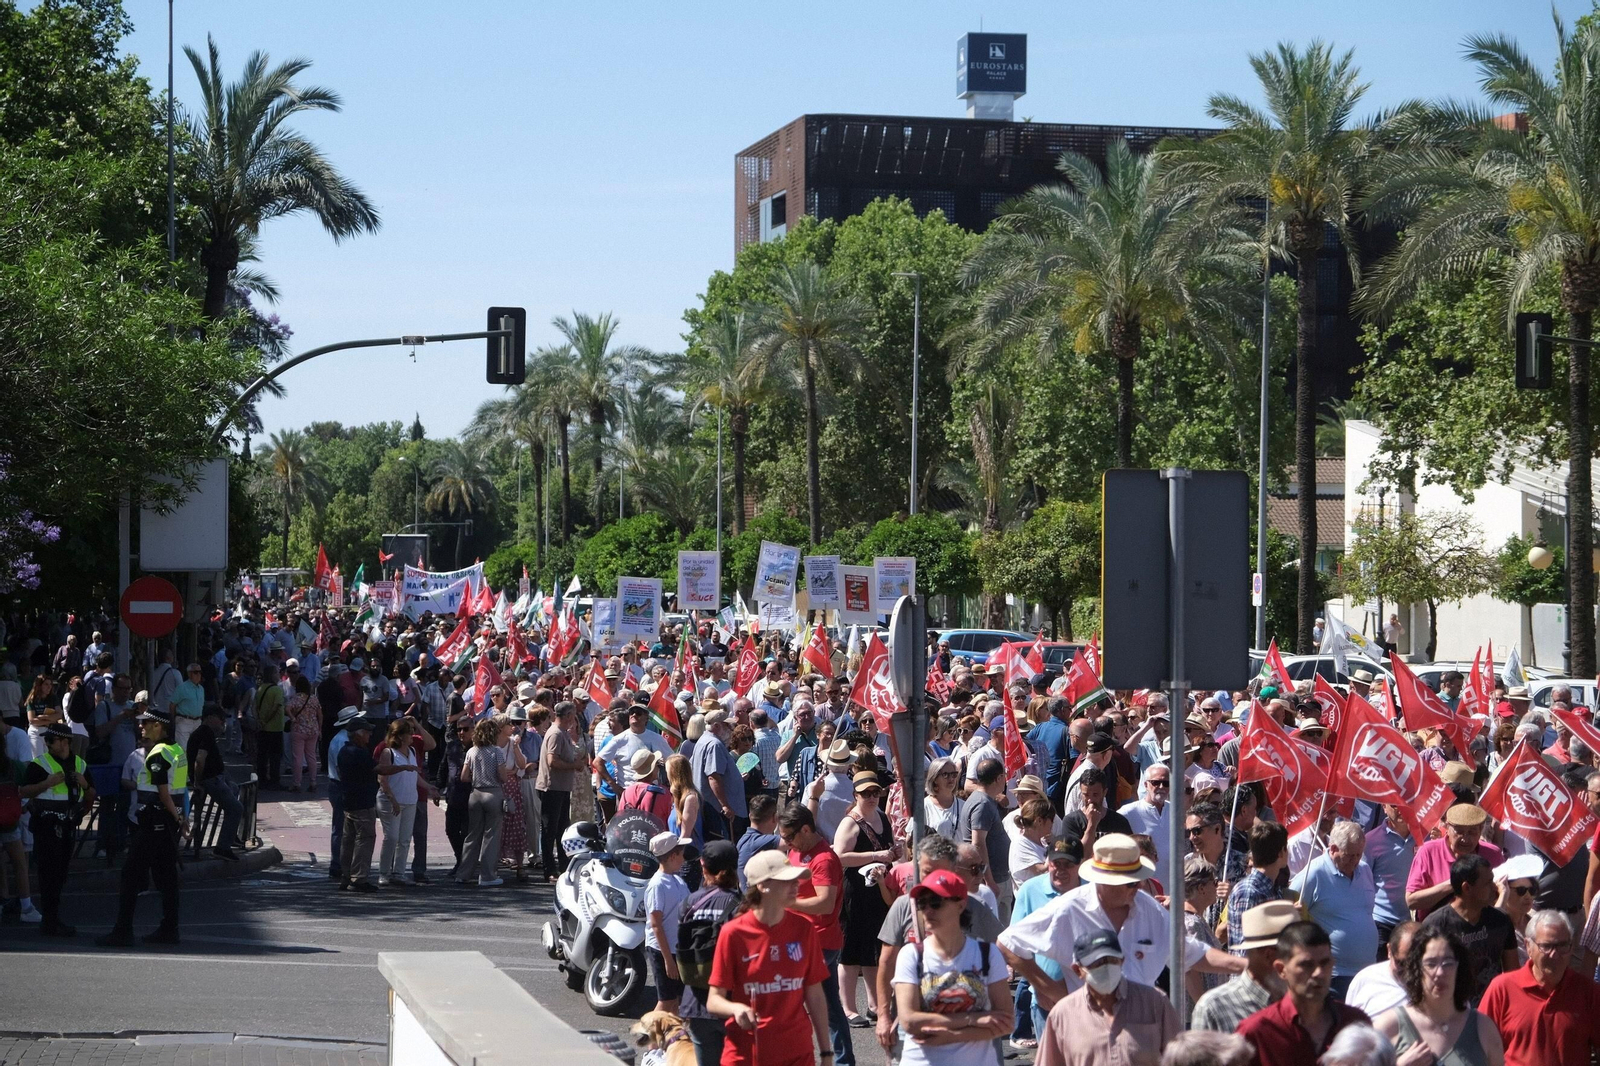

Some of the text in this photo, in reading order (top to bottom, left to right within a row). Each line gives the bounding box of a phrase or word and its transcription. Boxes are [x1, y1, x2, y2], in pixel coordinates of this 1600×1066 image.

[970, 62, 1024, 70] EUROSTARS
[764, 575, 791, 587] Ucrania
[1259, 736, 1297, 783] UGT
[1358, 728, 1418, 798] UGT
[1511, 766, 1569, 829] UGT
[617, 815, 643, 828] POLICIA
[1551, 814, 1596, 854] www.ugt.es
[1461, 925, 1489, 949] igual
[770, 945, 779, 955] 75
